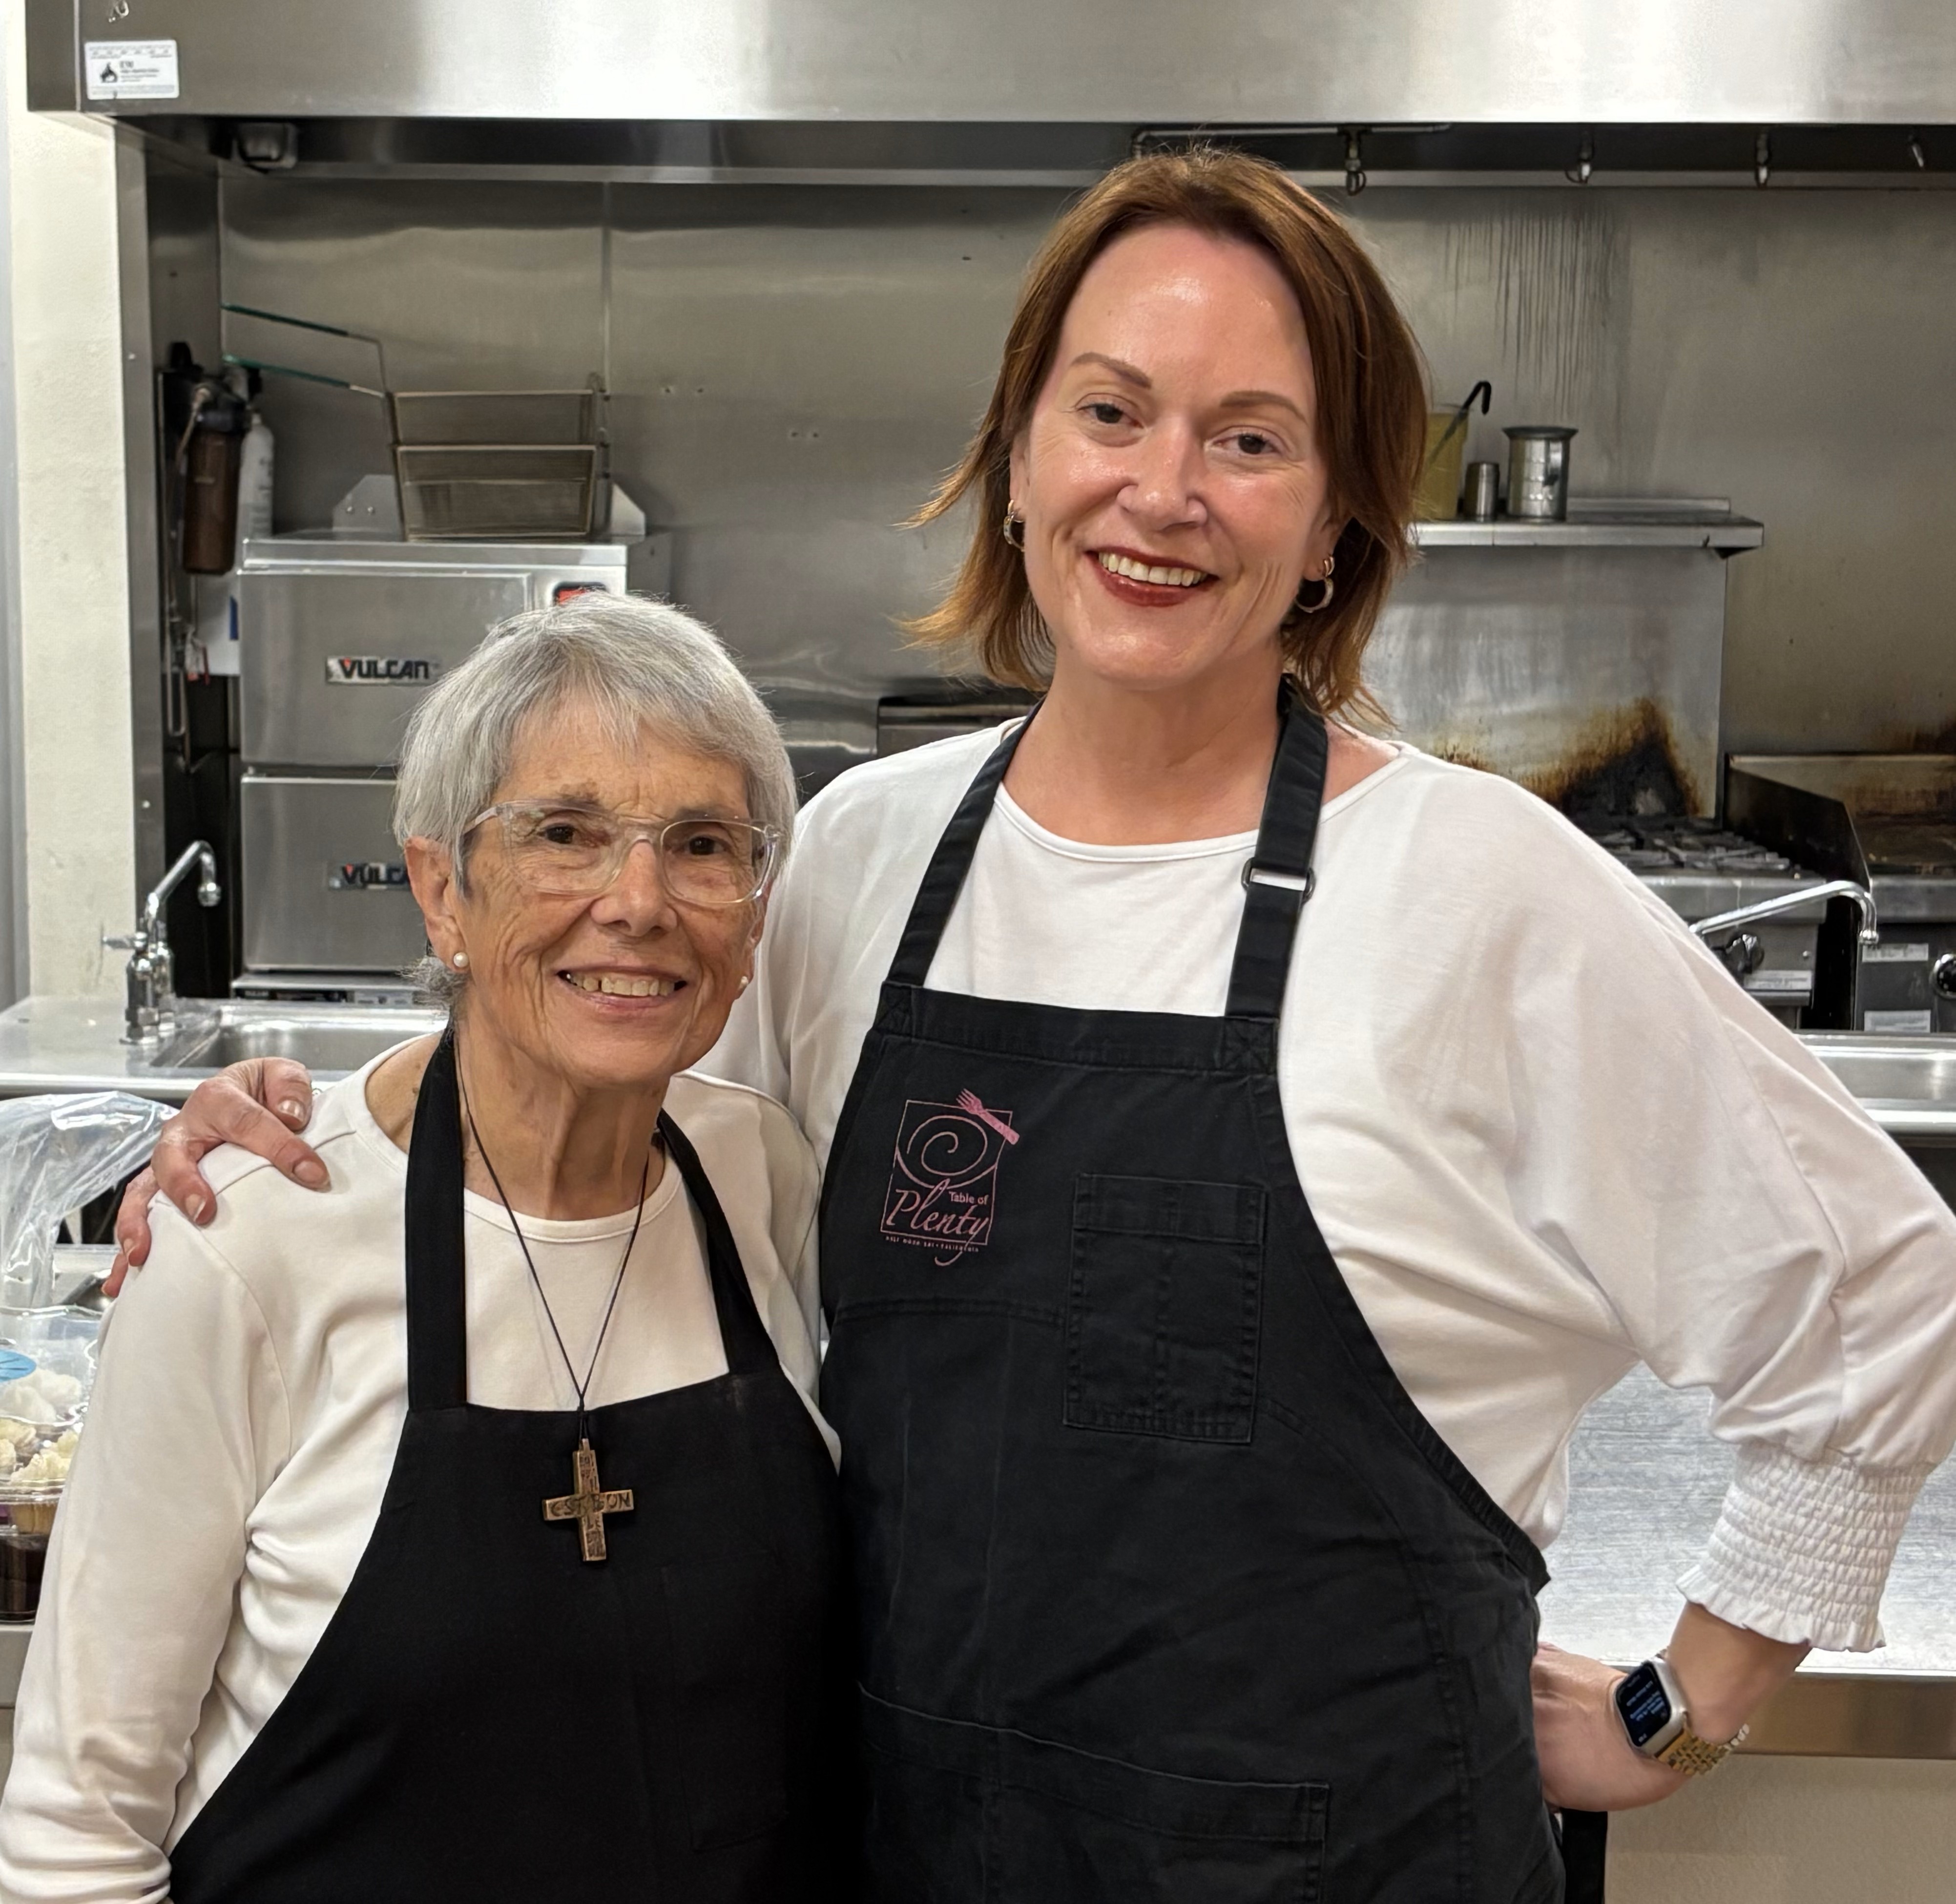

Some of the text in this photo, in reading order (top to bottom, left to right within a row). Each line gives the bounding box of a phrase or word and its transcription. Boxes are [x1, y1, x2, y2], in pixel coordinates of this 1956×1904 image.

[338, 659, 429, 679] VULCAN
[949, 1191, 989, 1205] Table of
[886, 1177, 989, 1266] Plenty
